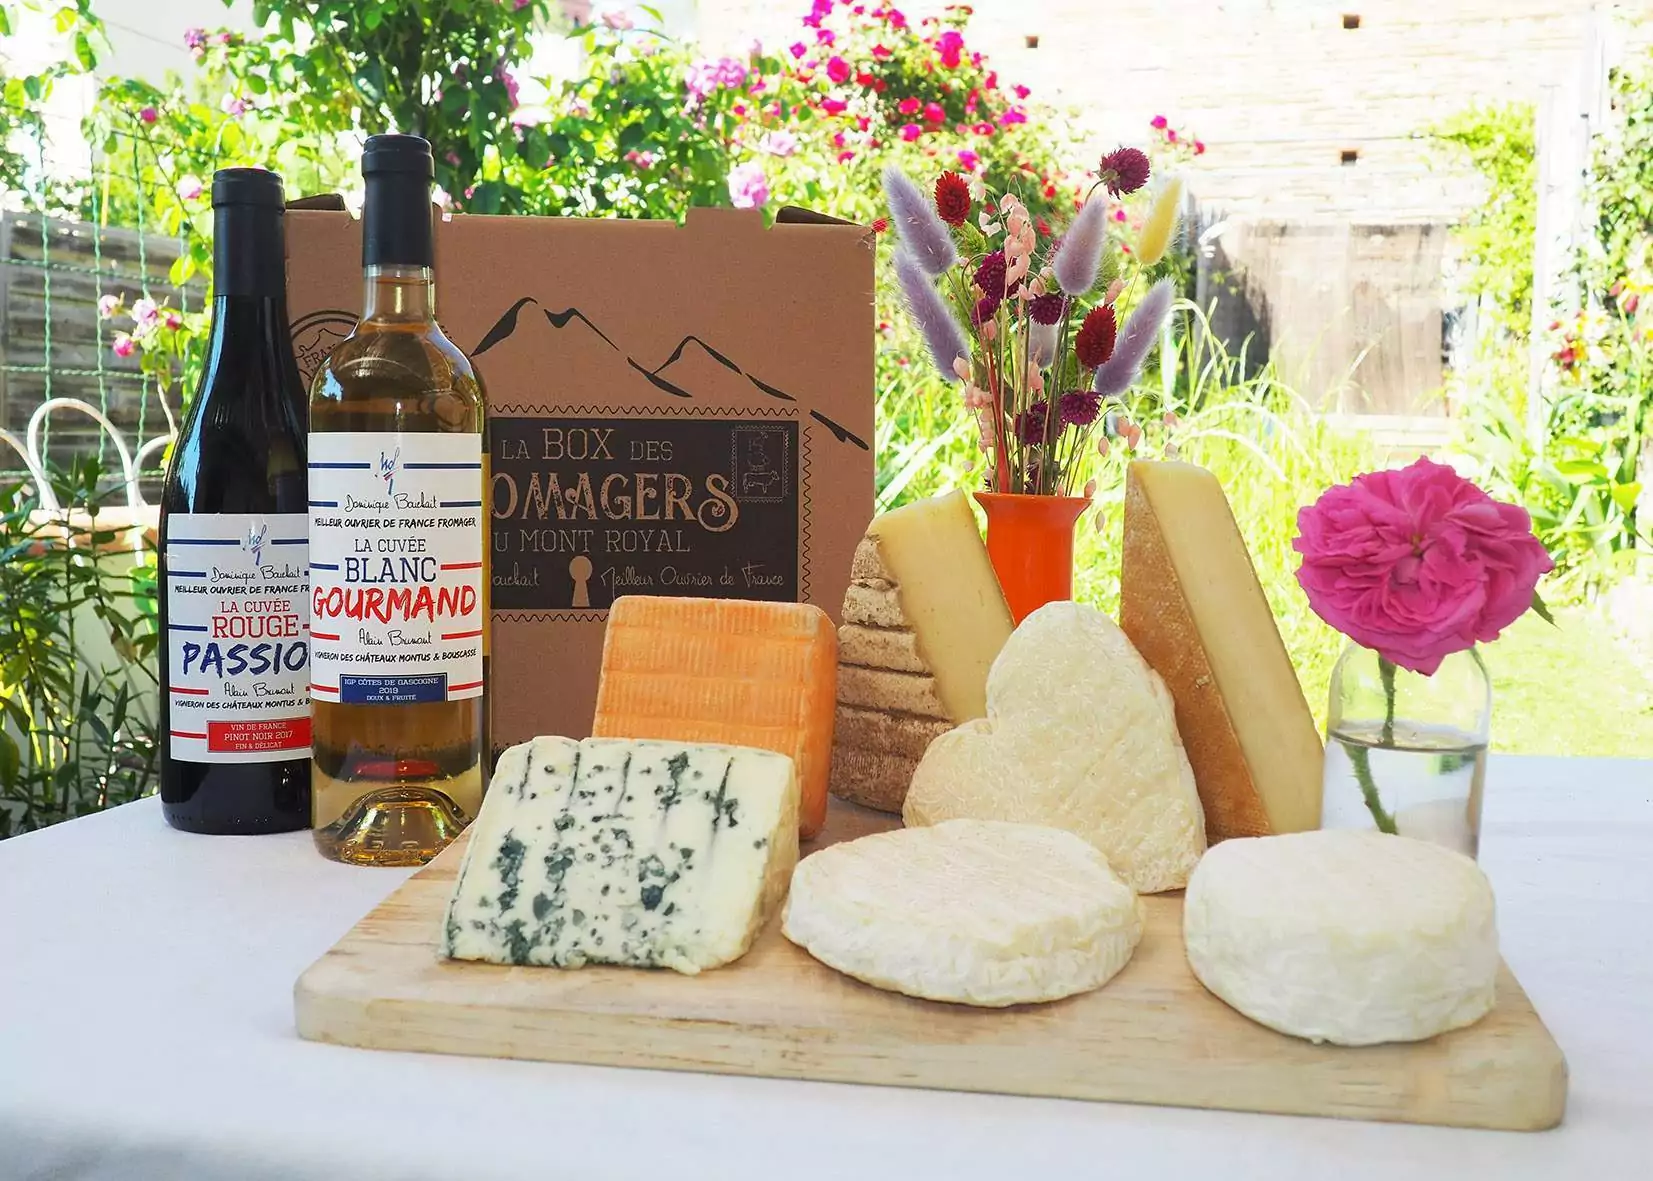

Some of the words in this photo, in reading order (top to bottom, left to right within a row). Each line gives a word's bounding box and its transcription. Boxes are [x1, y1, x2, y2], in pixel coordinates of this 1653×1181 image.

[501, 440, 531, 460] LA
[542, 428, 615, 460] BOX
[630, 441, 673, 461] DES
[314, 517, 343, 528] MEILLEUR
[344, 518, 381, 529] OUVRIER
[383, 518, 396, 528] DE
[399, 518, 435, 529] FRANCE
[437, 517, 477, 529] FROMAGER
[354, 538, 373, 552] LA
[377, 536, 426, 552] CUVÉE
[519, 529, 594, 552] MONT
[604, 529, 691, 552] ROYAL
[344, 556, 437, 582] BLANC
[600, 566, 653, 600] Meilleur
[660, 566, 713, 586] Ouvrier
[719, 565, 735, 585] de
[741, 561, 785, 588] France
[174, 585, 208, 595] MEILLEUR
[210, 585, 247, 595] OUVRIER
[249, 586, 262, 594] DE
[264, 584, 298, 594] FRANCE
[220, 601, 239, 613] LA
[244, 598, 290, 612] CUVÉE
[312, 585, 477, 624] GOURMAND
[211, 614, 299, 638] ROUGE
[358, 628, 383, 646] Alain
[182, 641, 311, 678] PASSIO
[314, 651, 339, 662] VIGNERON
[340, 653, 354, 662] DES
[399, 653, 431, 662] MONTUS
[432, 652, 440, 661] &
[397, 677, 439, 685] GASCOGNE
[224, 682, 249, 697] Alain
[175, 700, 204, 709] VIGNERON
[206, 701, 220, 709] DES
[265, 699, 295, 709] MONTUS
[296, 698, 303, 706] &
[230, 723, 245, 731] VIN
[247, 723, 257, 731] DE
[258, 721, 287, 731] FRANCE
[224, 732, 250, 741] PINOT
[252, 731, 273, 741] NOIR
